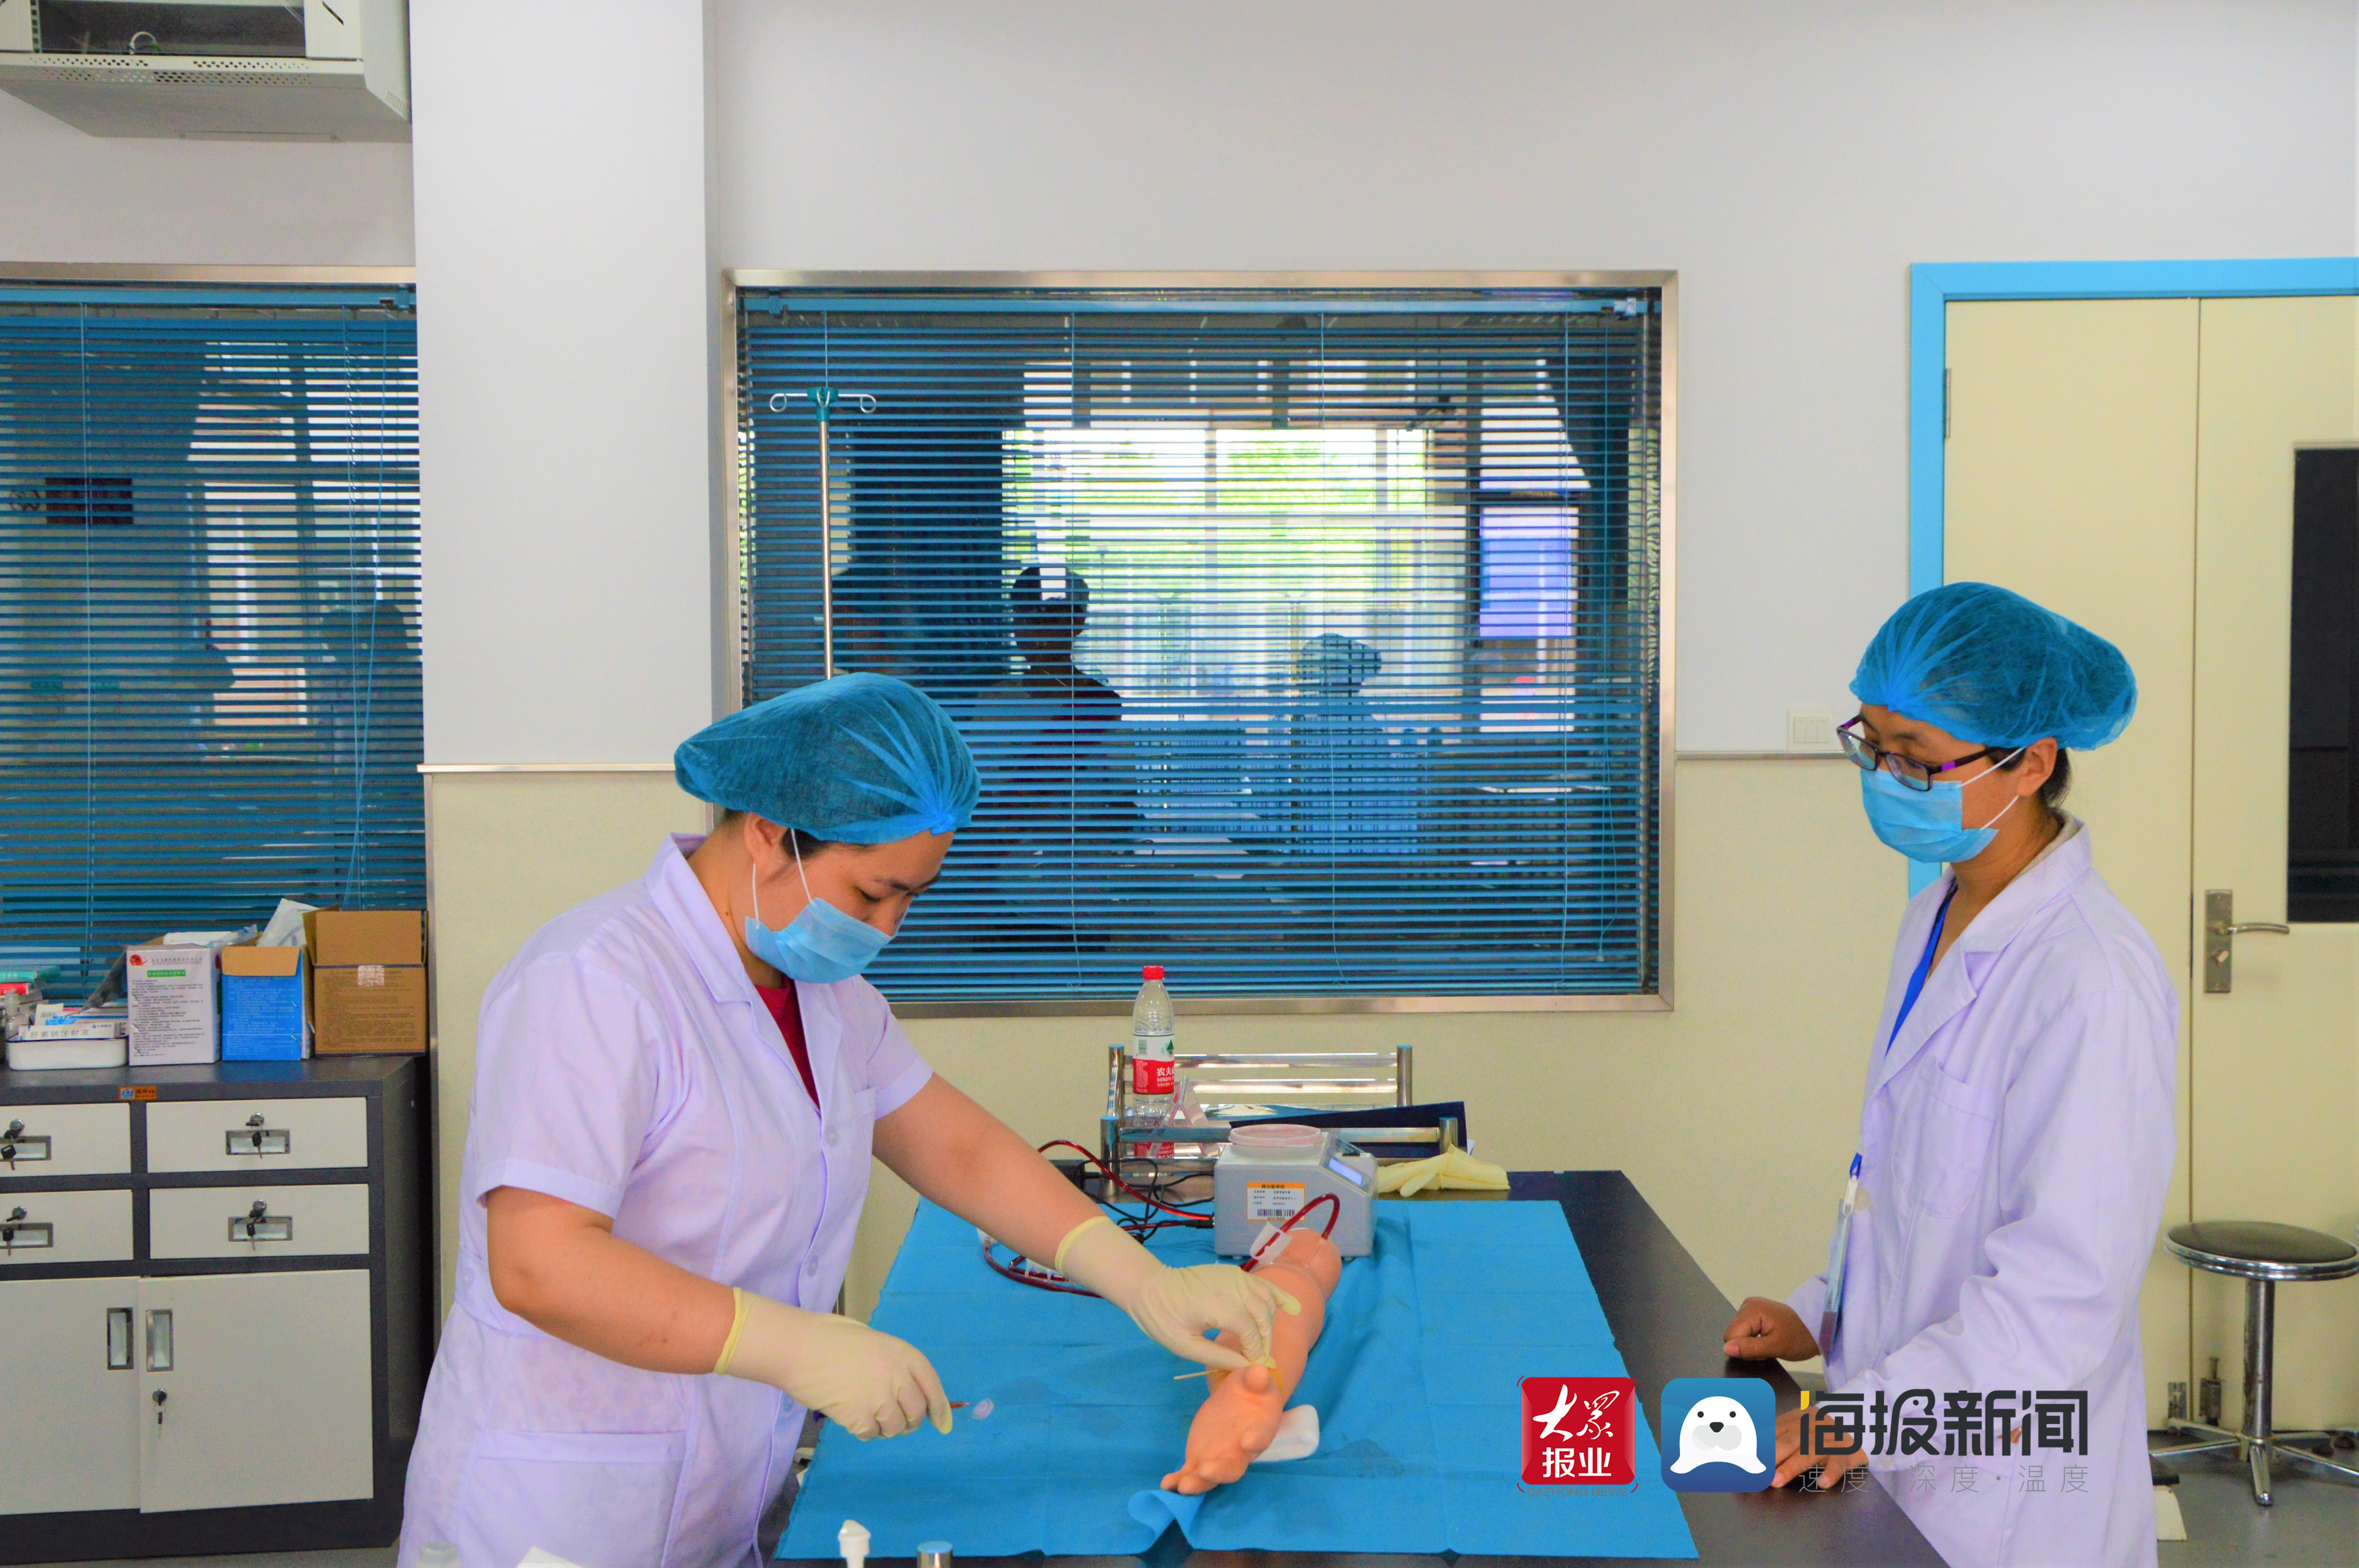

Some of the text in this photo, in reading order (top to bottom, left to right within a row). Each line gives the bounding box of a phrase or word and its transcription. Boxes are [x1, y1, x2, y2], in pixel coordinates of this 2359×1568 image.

[30, 1029, 89, 1038] 肝素钠注射液
